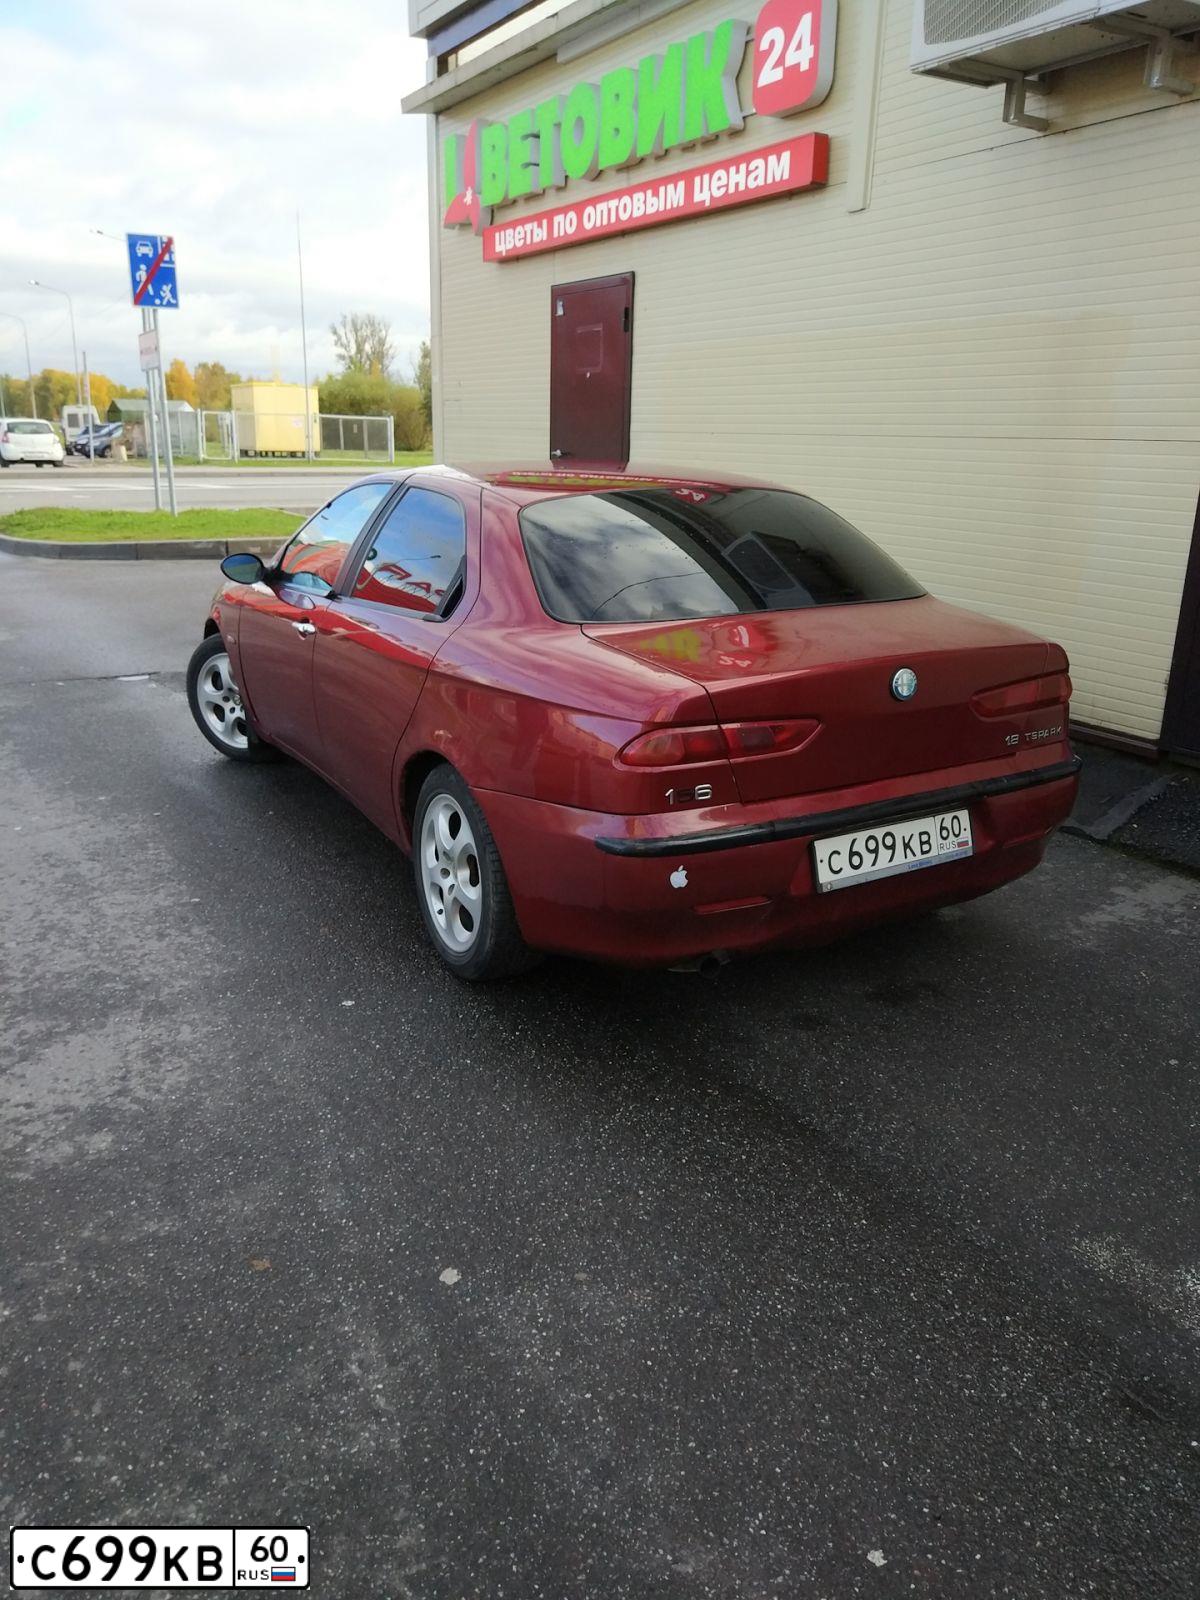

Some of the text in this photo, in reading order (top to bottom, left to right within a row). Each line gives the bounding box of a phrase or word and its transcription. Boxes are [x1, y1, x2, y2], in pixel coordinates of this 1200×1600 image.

[757, 12, 815, 89] 24
[494, 150, 791, 257] цветы по оптовым ценам
[827, 814, 962, 875] С699КВ 60
[939, 840, 957, 852] RUS
